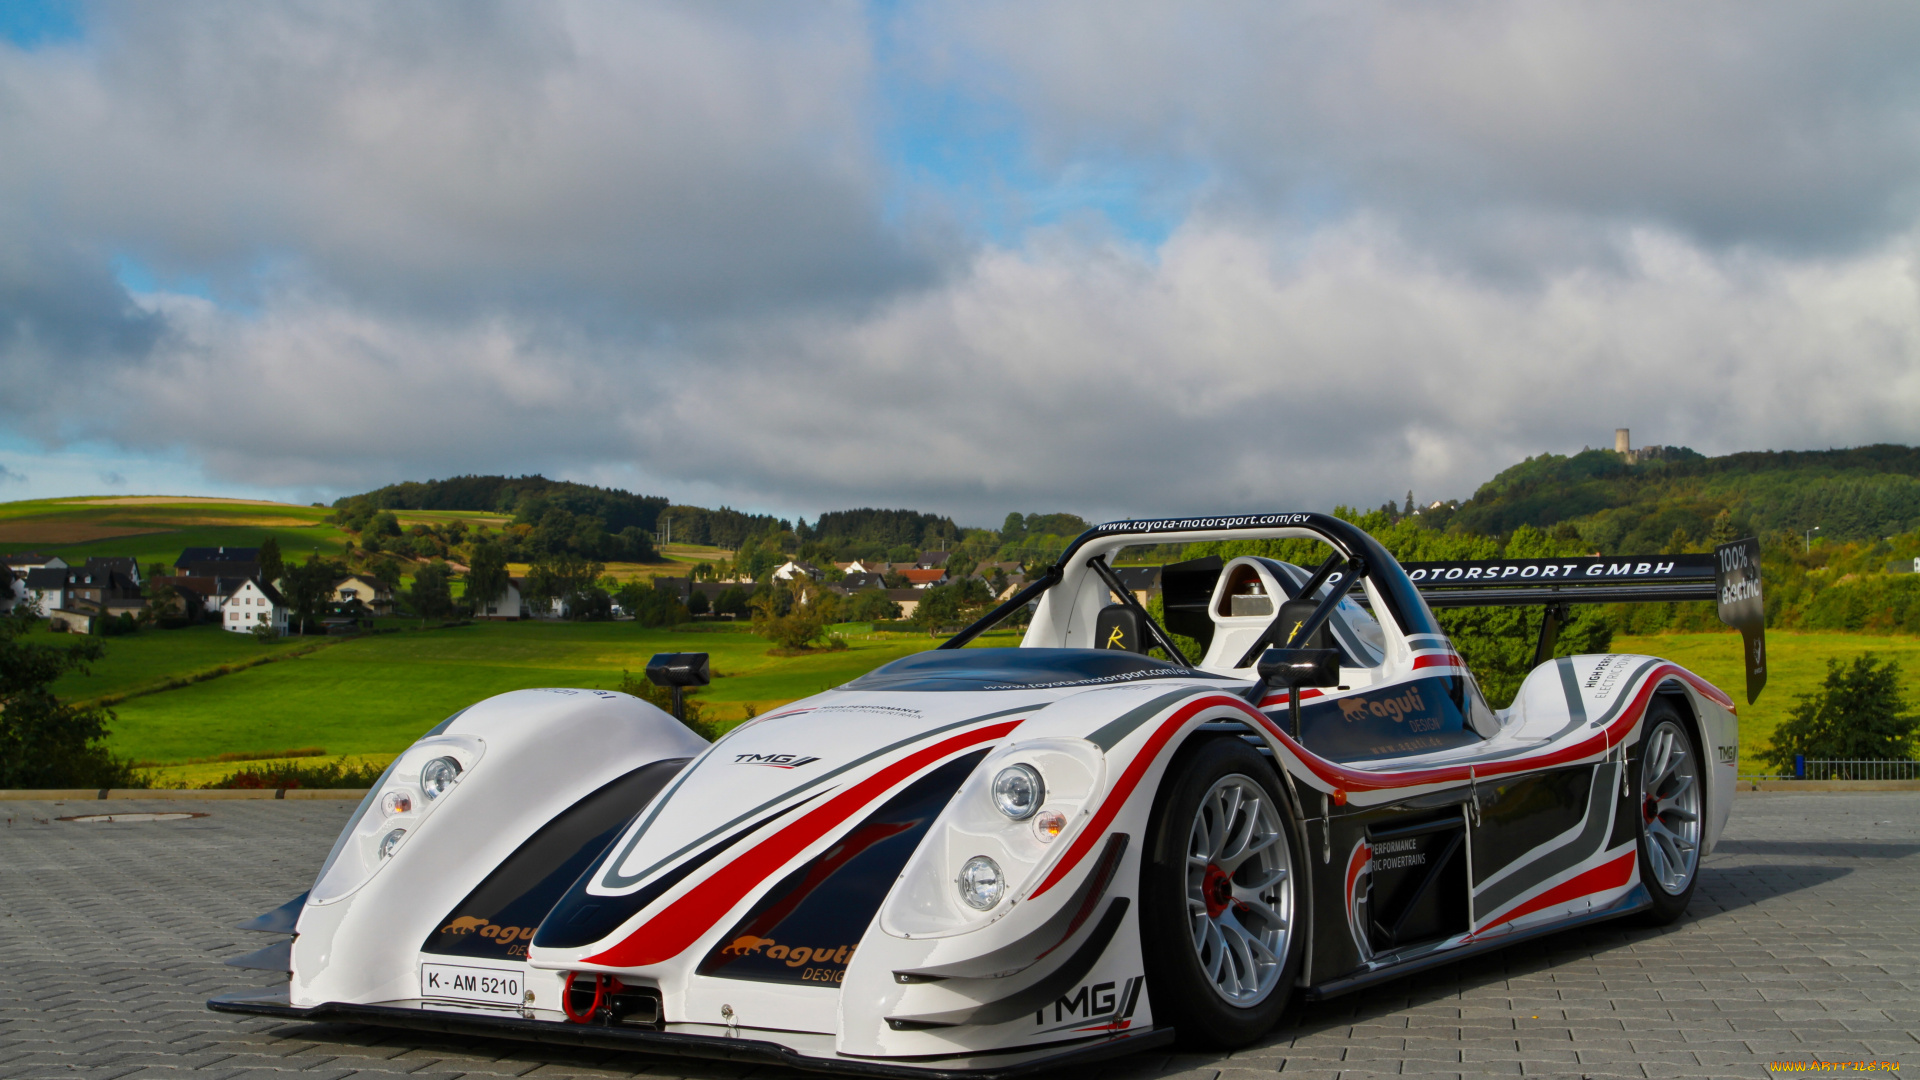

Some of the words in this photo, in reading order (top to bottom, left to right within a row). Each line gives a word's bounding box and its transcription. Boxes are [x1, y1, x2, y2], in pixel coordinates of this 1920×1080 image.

[1098, 513, 1310, 532] www.toyota-motorsport.com/ev
[1719, 544, 1748, 573] 100%
[1404, 564, 1576, 581] OTORSPORT
[1585, 562, 1675, 577] GMBH
[1721, 574, 1760, 605] electric
[984, 667, 1190, 690] www.toyota-motorsport.com/ev
[1584, 671, 1603, 688] HIGH
[1369, 686, 1426, 723] aguti
[1409, 717, 1441, 733] DESIGN
[1383, 853, 1426, 870] POWERTRAINS
[429, 972, 440, 989] K
[453, 974, 477, 992] AM
[481, 977, 518, 996] 5210
[802, 967, 847, 983] DESIG
